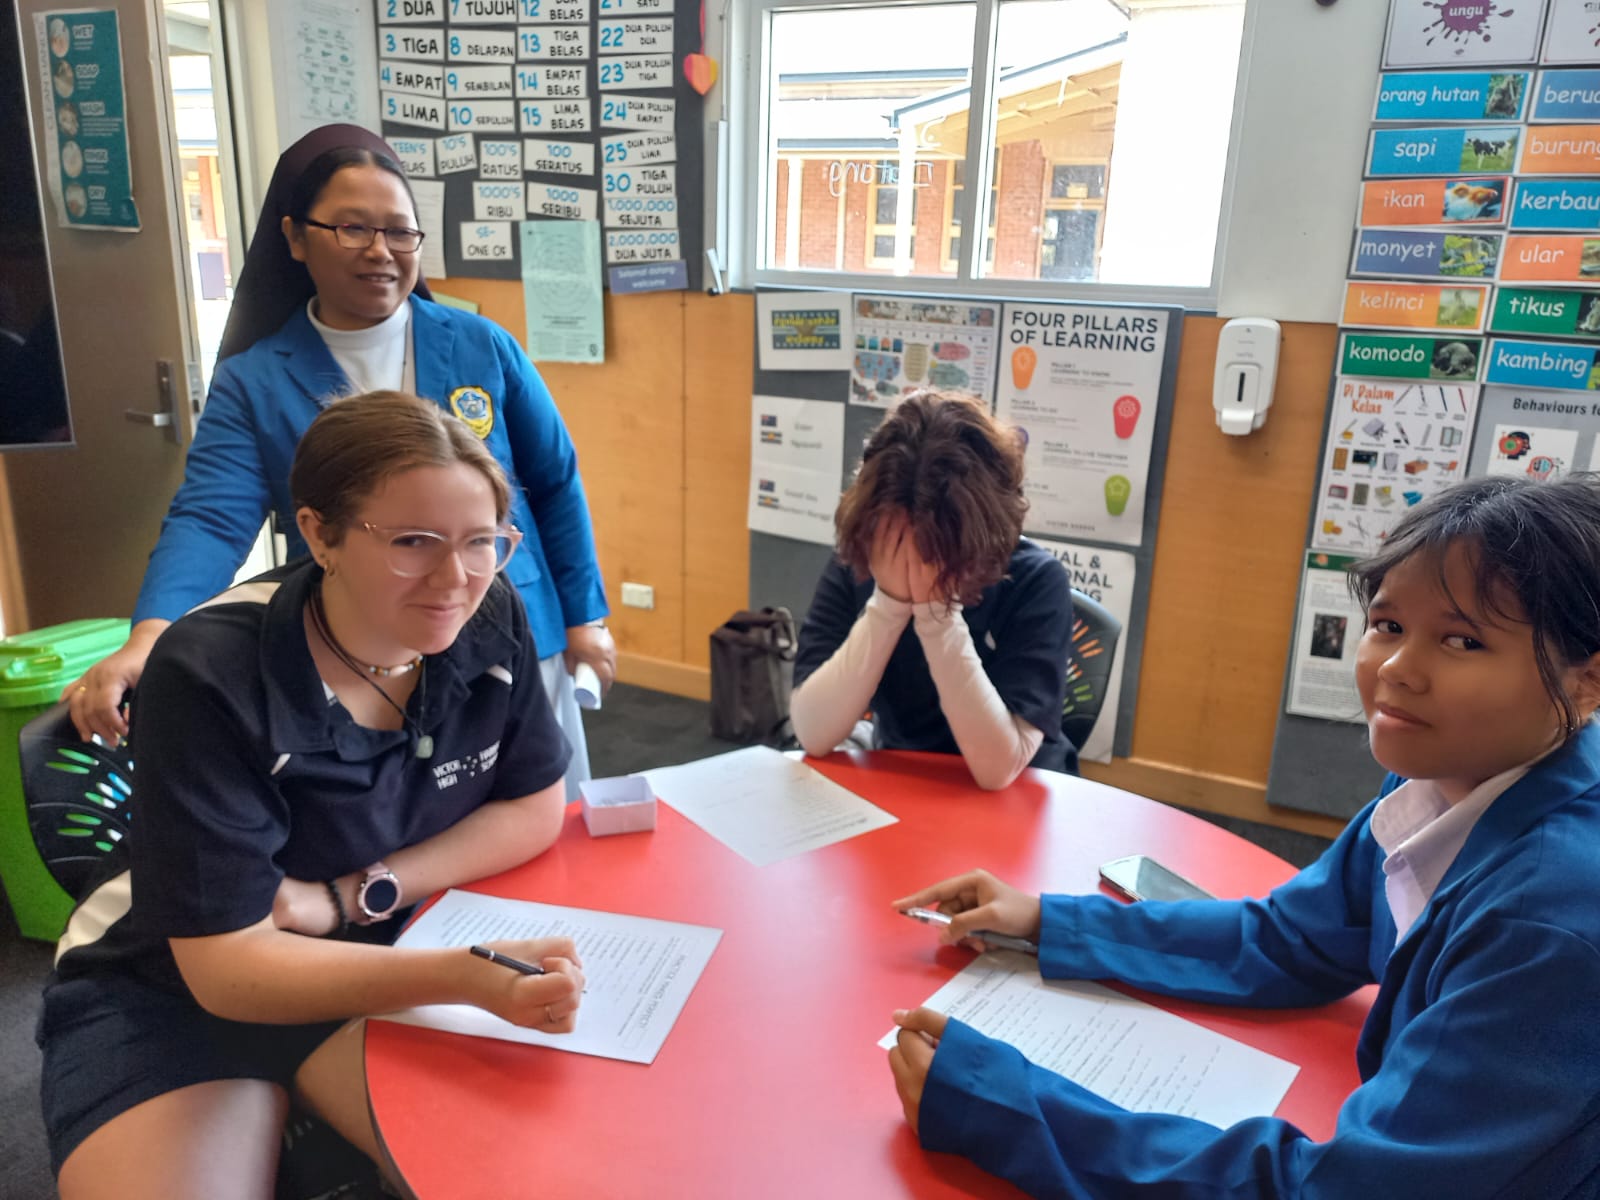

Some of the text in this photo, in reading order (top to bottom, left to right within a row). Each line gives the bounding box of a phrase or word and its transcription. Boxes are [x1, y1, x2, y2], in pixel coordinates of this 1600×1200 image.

[387, 0, 434, 17] 2 DUA
[451, 0, 515, 16] 7 TUJUH
[520, 0, 540, 16] 12
[550, 9, 583, 20] BELAS
[1450, 4, 1484, 19] ungu
[554, 30, 579, 41] TIGA
[626, 24, 672, 32] DUA PULUH
[386, 34, 438, 54] 3 TIGA
[520, 34, 541, 52] 13
[601, 28, 624, 46] 22
[640, 37, 656, 45] DUA
[450, 36, 514, 56] 8 DELAPAN
[550, 46, 583, 56] BELAS
[625, 59, 671, 69] DUA PULUH
[382, 67, 442, 90] 4 EMPAT
[518, 72, 538, 90] 14
[546, 69, 581, 80] EMPAT
[601, 64, 624, 83] 23
[638, 73, 657, 81] TIGA
[448, 73, 510, 92] 9 SEMBILAN
[547, 86, 580, 96] BELAS
[1380, 86, 1480, 105] orang hutan
[388, 98, 439, 122] 5 LIMA
[554, 104, 580, 114] LIMA
[603, 102, 627, 120] 24
[628, 101, 673, 112] DUA PULUH
[450, 107, 472, 125] 10
[522, 106, 542, 126] 15
[550, 119, 584, 129] BELAS
[637, 115, 663, 124] EMPAT
[442, 137, 466, 150] 10'S
[484, 144, 517, 156] 100'S
[546, 144, 572, 158] 100
[627, 139, 645, 148] DUA
[1394, 138, 1437, 162] sapi
[605, 142, 627, 162] 25
[642, 151, 661, 159] LIMA
[400, 162, 425, 173] ELAS
[440, 156, 474, 170] PULUH
[483, 164, 518, 176] RATUS
[535, 160, 582, 173] SERATUS
[605, 173, 631, 192] 30
[642, 170, 667, 180] TIGA
[478, 186, 520, 199] 1000'S
[546, 188, 579, 203] 1000
[636, 184, 672, 193] PULUH
[1383, 190, 1425, 208] ikan
[1520, 190, 1600, 210] kerbau
[488, 206, 512, 217] RIBU
[541, 203, 581, 218] SERIBU
[619, 215, 662, 226] SEJUTA
[467, 244, 506, 256] ONE OF
[616, 248, 671, 259] DUA JUTA
[1360, 240, 1436, 262] monyet
[1520, 244, 1564, 264] ular
[1359, 292, 1424, 310] kelinci
[1510, 296, 1564, 317] tikus
[1012, 310, 1065, 328] FOUR
[1072, 314, 1158, 333] PILLARS
[1010, 329, 1037, 344] OF
[1042, 330, 1156, 352] LEARNING
[1349, 342, 1424, 362] komodo
[1497, 348, 1588, 378] kambing
[1358, 384, 1394, 400] Dalam
[1352, 399, 1382, 415] Kelas
[1513, 397, 1586, 416] Behaviours
[1045, 548, 1101, 569] IAL &
